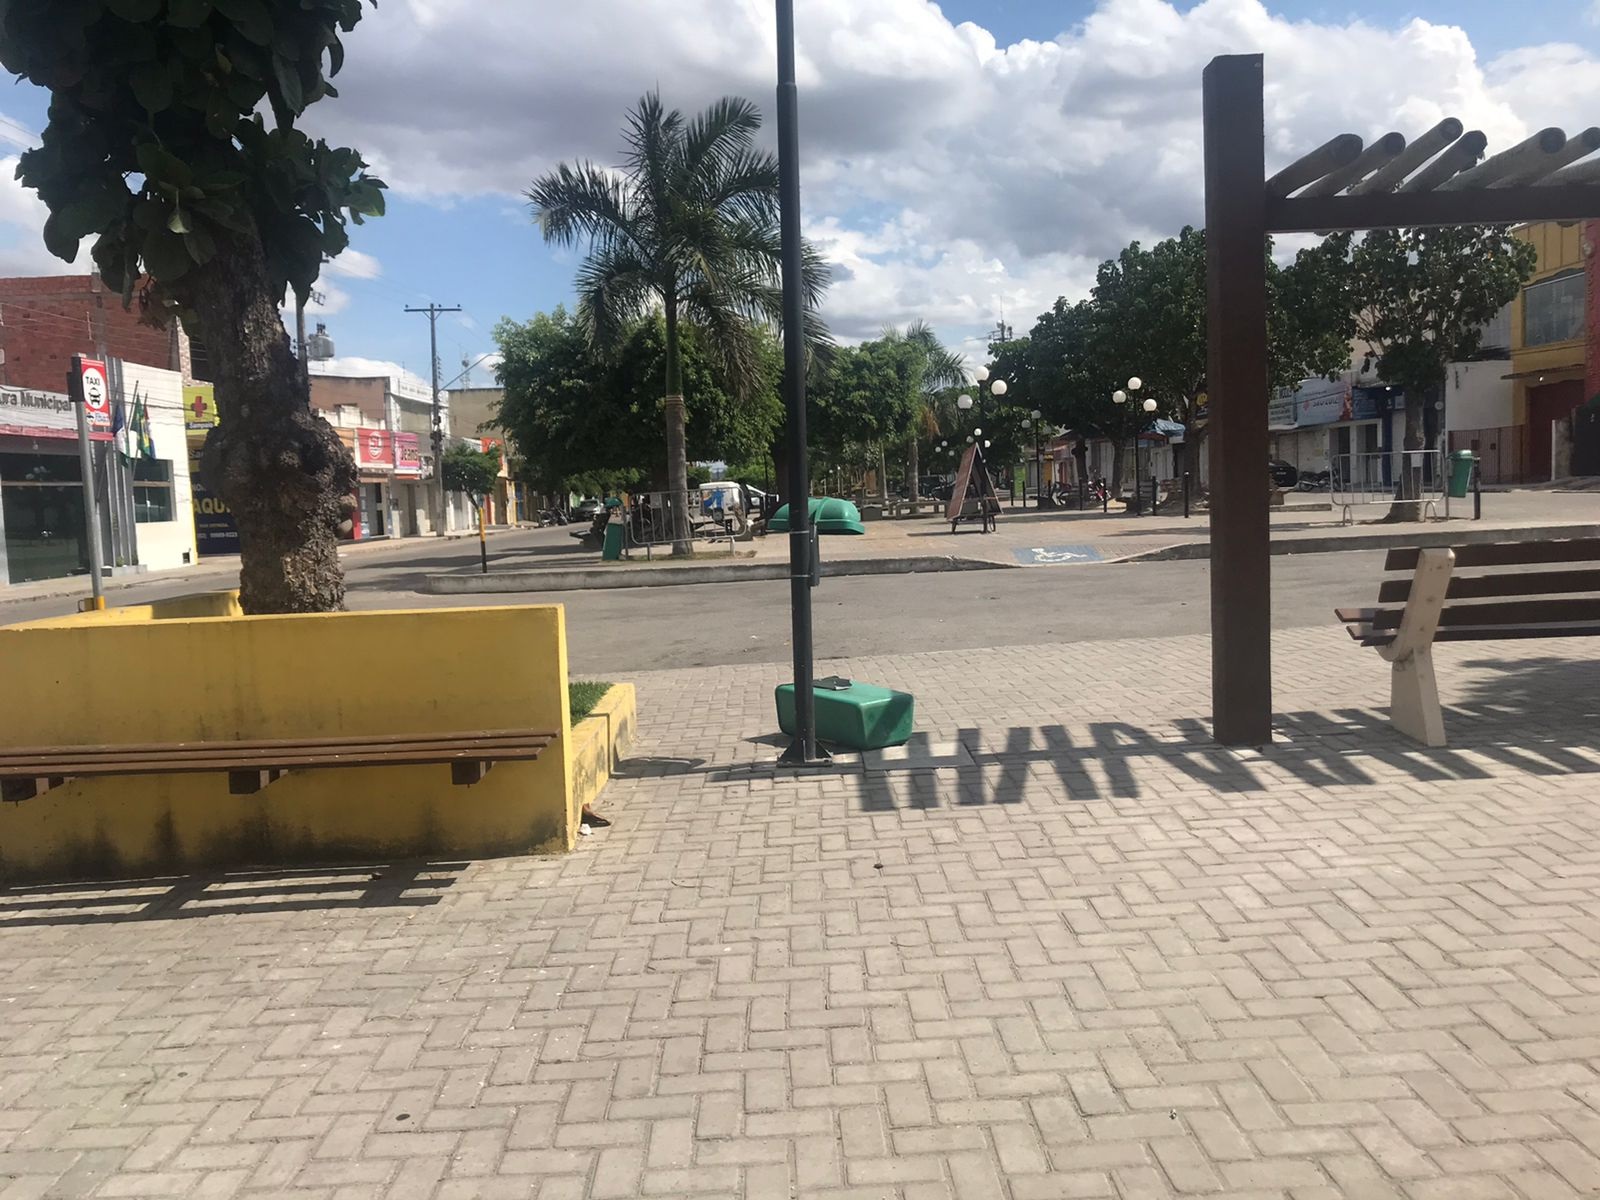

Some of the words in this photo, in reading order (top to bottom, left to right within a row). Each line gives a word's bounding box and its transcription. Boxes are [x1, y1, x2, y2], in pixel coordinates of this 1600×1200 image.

[85, 376, 100, 386] TAXI
[20, 390, 72, 414] Municipal
[193, 497, 231, 514] AQU
